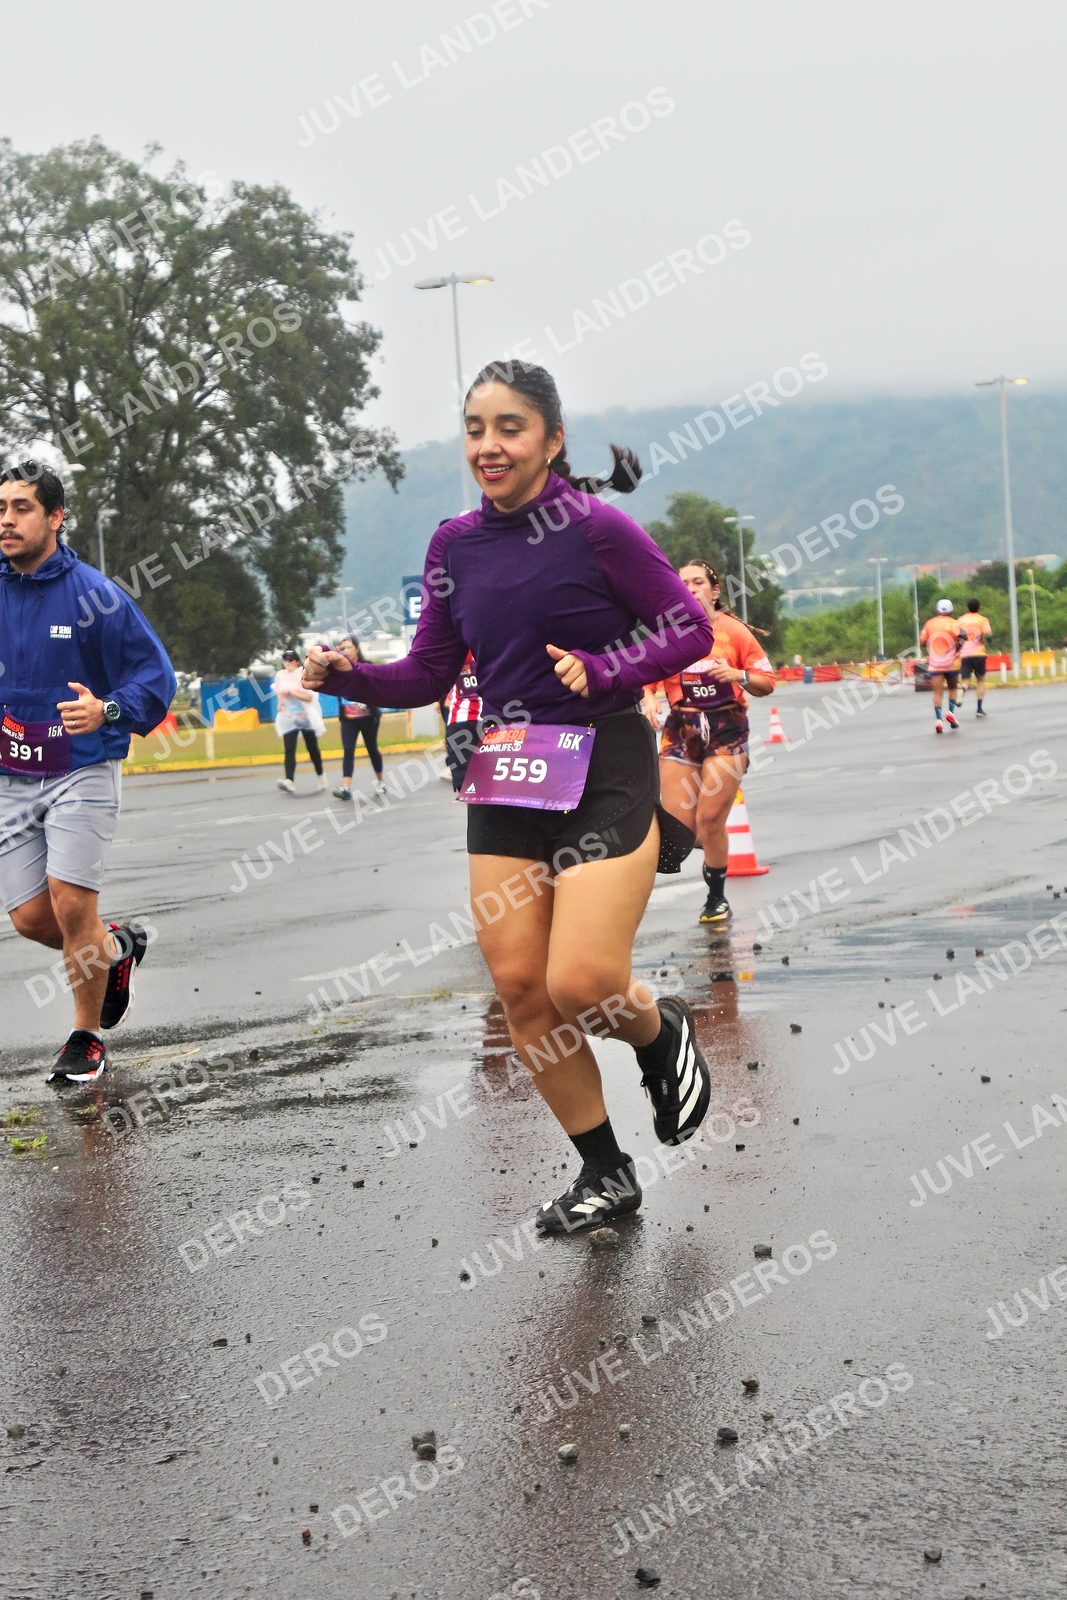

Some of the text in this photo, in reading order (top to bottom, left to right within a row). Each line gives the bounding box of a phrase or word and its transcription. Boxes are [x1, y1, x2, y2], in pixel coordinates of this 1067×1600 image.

[692, 684, 717, 698] 505
[9, 741, 43, 762] 391
[492, 757, 548, 784] 559
